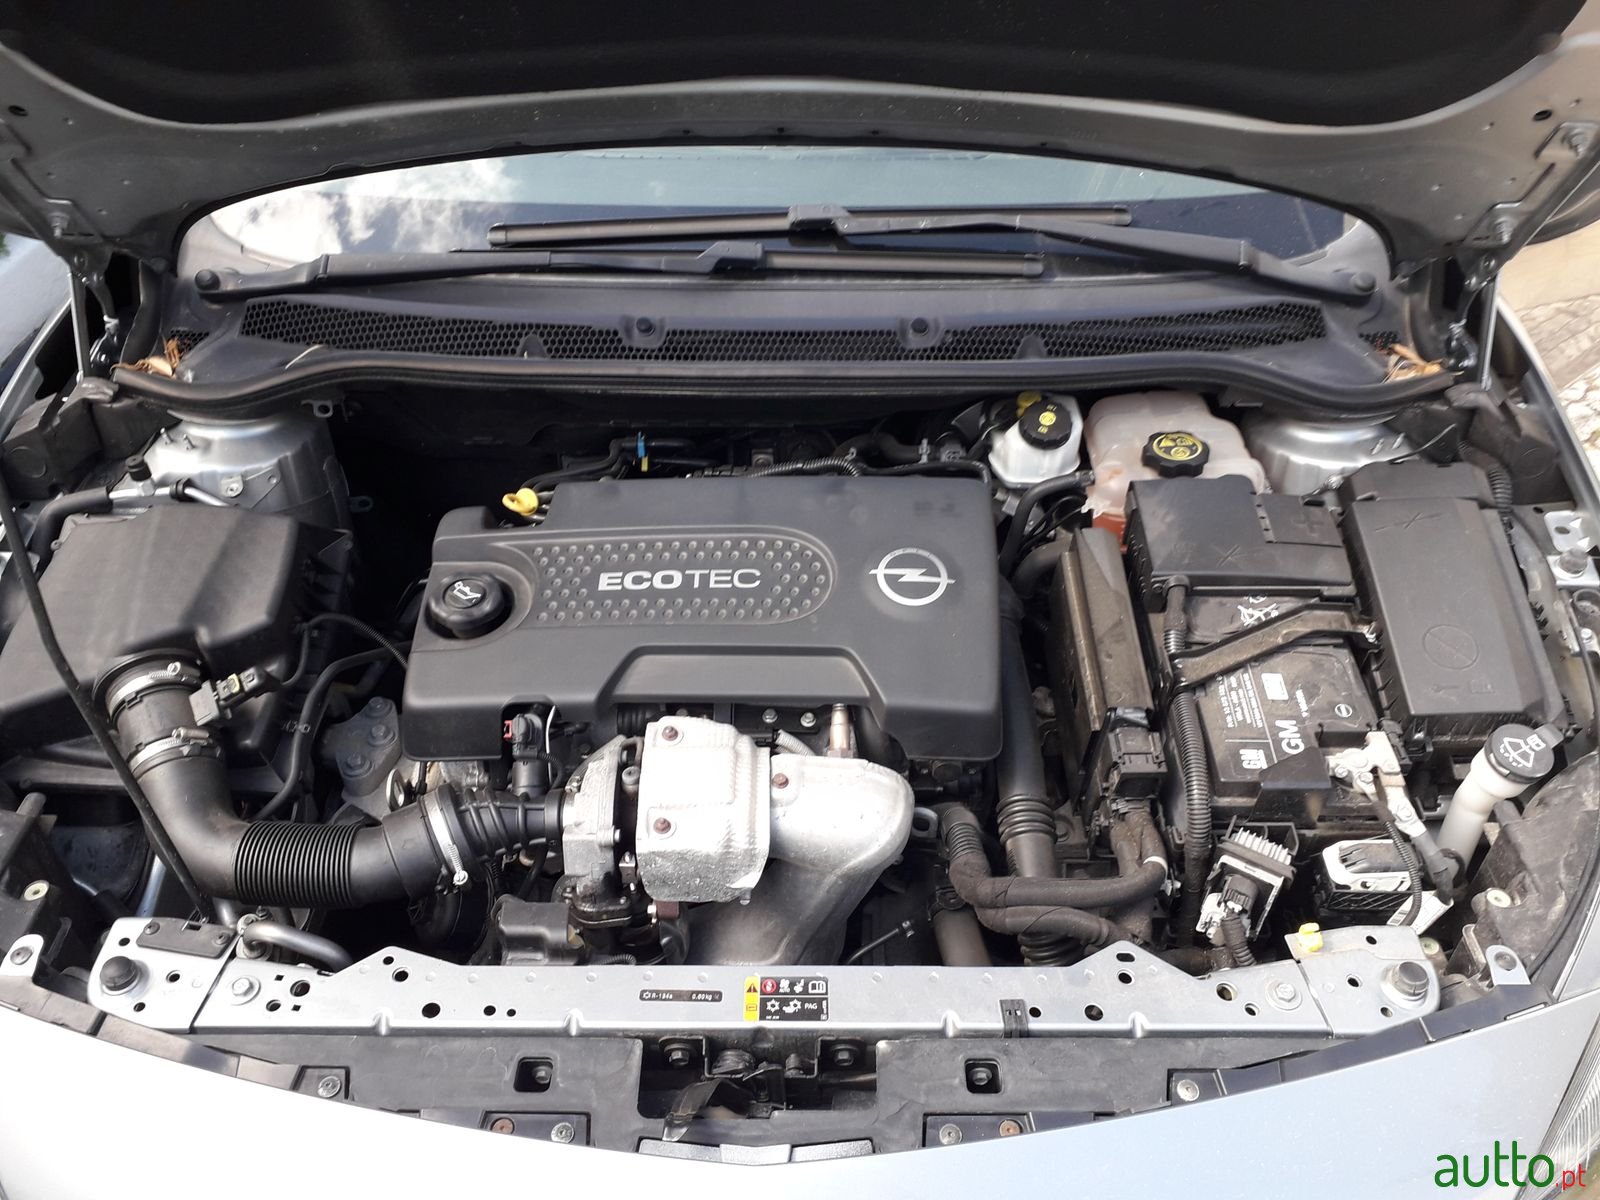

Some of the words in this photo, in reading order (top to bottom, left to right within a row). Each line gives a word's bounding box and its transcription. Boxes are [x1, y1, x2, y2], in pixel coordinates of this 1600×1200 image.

[598, 569, 761, 591] ECOTEC
[1275, 720, 1305, 754] GM
[804, 1002, 818, 1010] PAG
